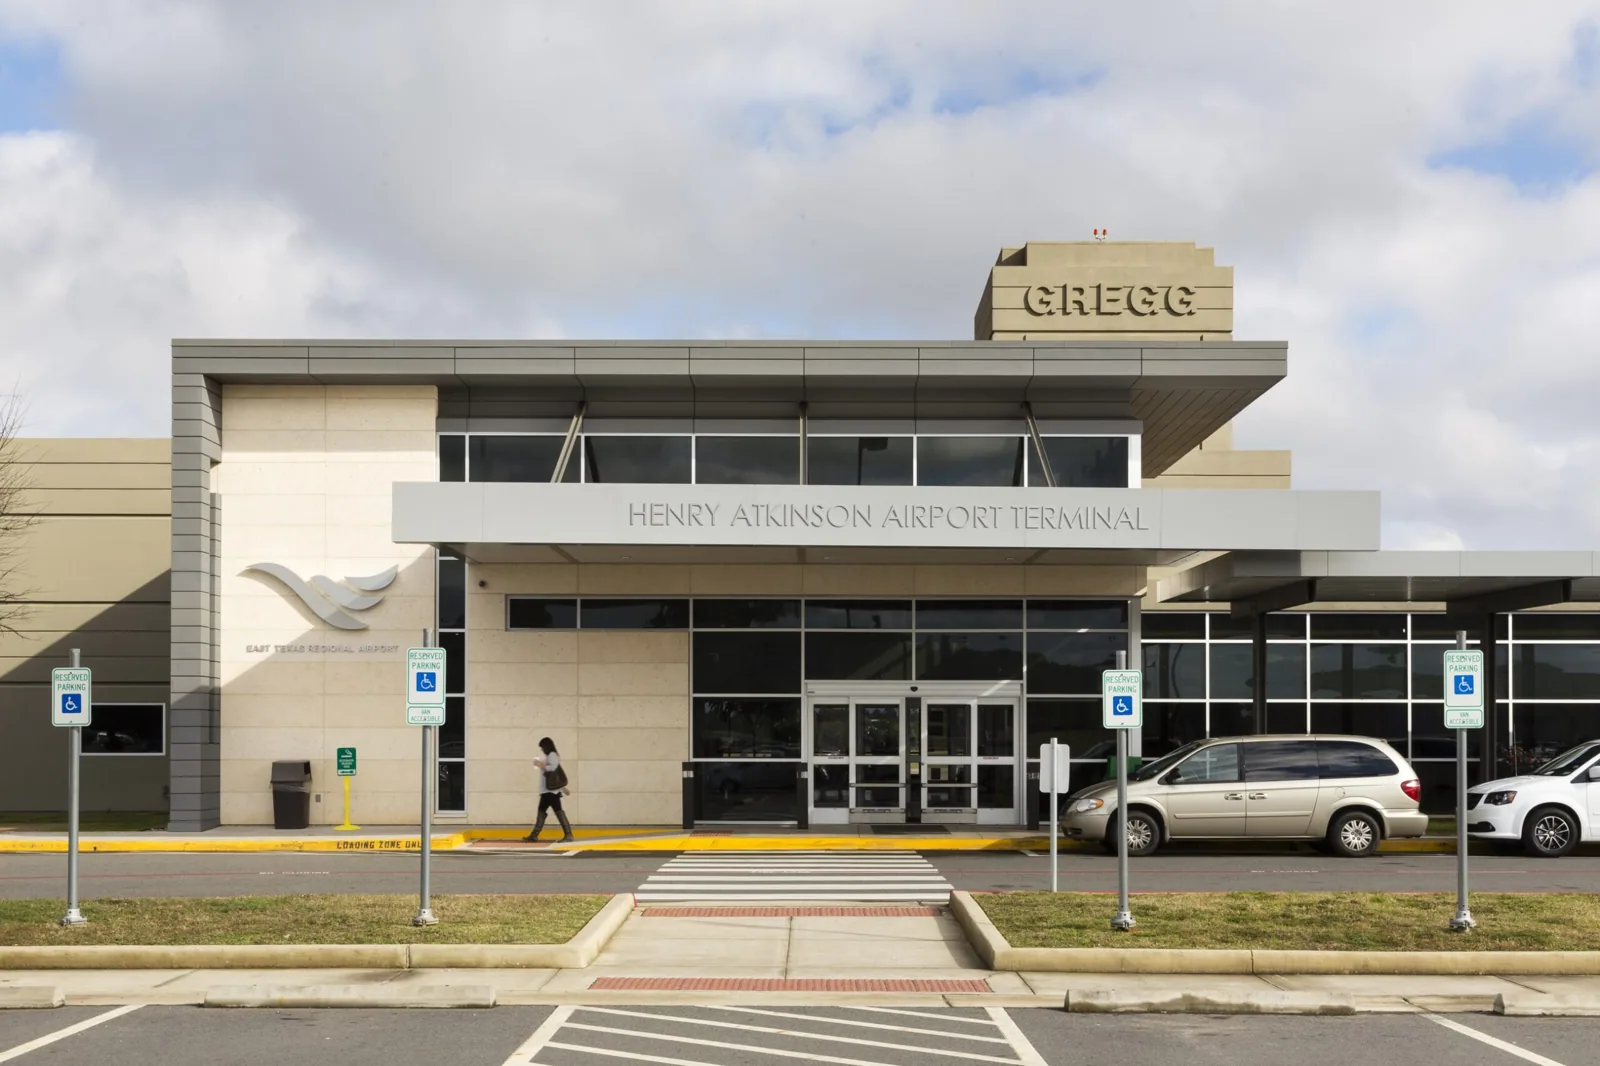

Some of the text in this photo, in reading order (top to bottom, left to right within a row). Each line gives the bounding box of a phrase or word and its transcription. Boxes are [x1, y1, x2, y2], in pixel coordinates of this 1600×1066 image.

[1024, 282, 1196, 317] GREGG
[629, 502, 1149, 532] HENRY ATKINSON AIRPORT TERMINAL
[246, 644, 399, 654] EAST TEXAS REGIONAL AIRPORT
[336, 840, 422, 850] LOADING ZONE ONL
